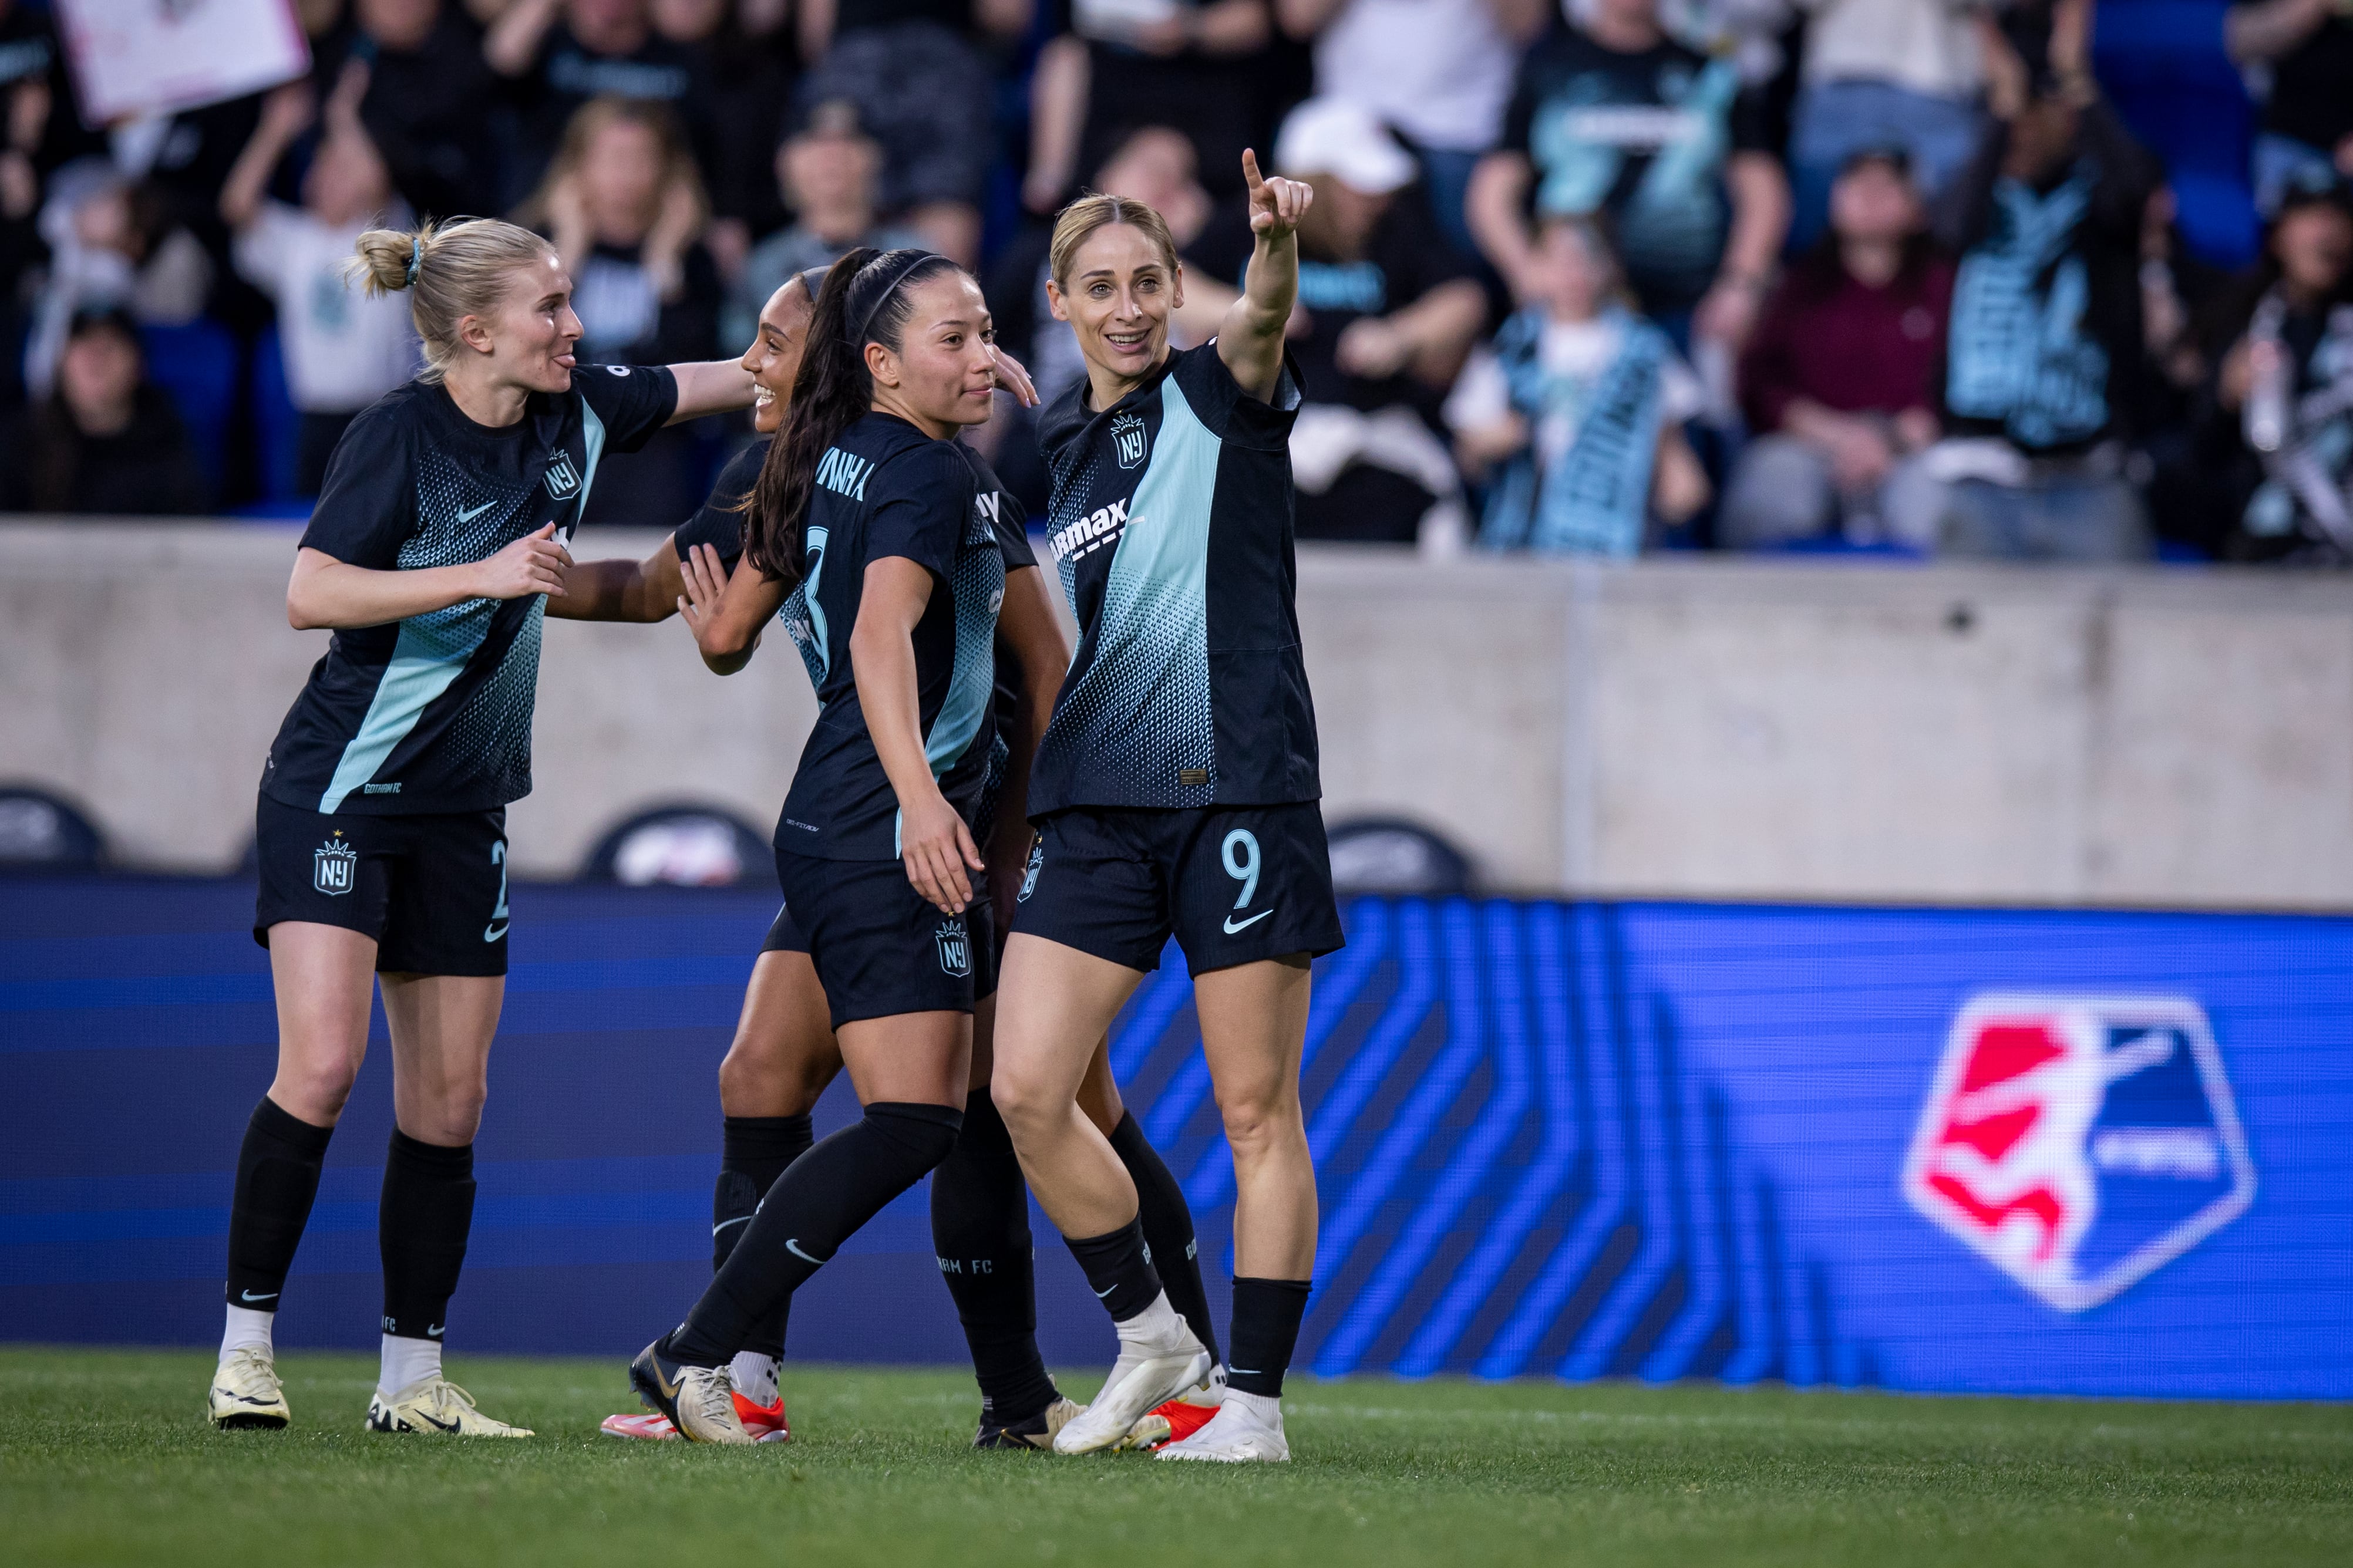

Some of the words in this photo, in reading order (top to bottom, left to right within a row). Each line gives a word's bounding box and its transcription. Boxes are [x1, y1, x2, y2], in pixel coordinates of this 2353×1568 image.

[1120, 431, 1143, 463] NY
[546, 462, 575, 494] NY
[364, 783, 393, 794] GOTHAM
[392, 782, 402, 793] FC
[322, 859, 348, 887] NY
[1221, 828, 1261, 909] 9
[944, 942, 967, 968] NY
[972, 1259, 992, 1274] FC
